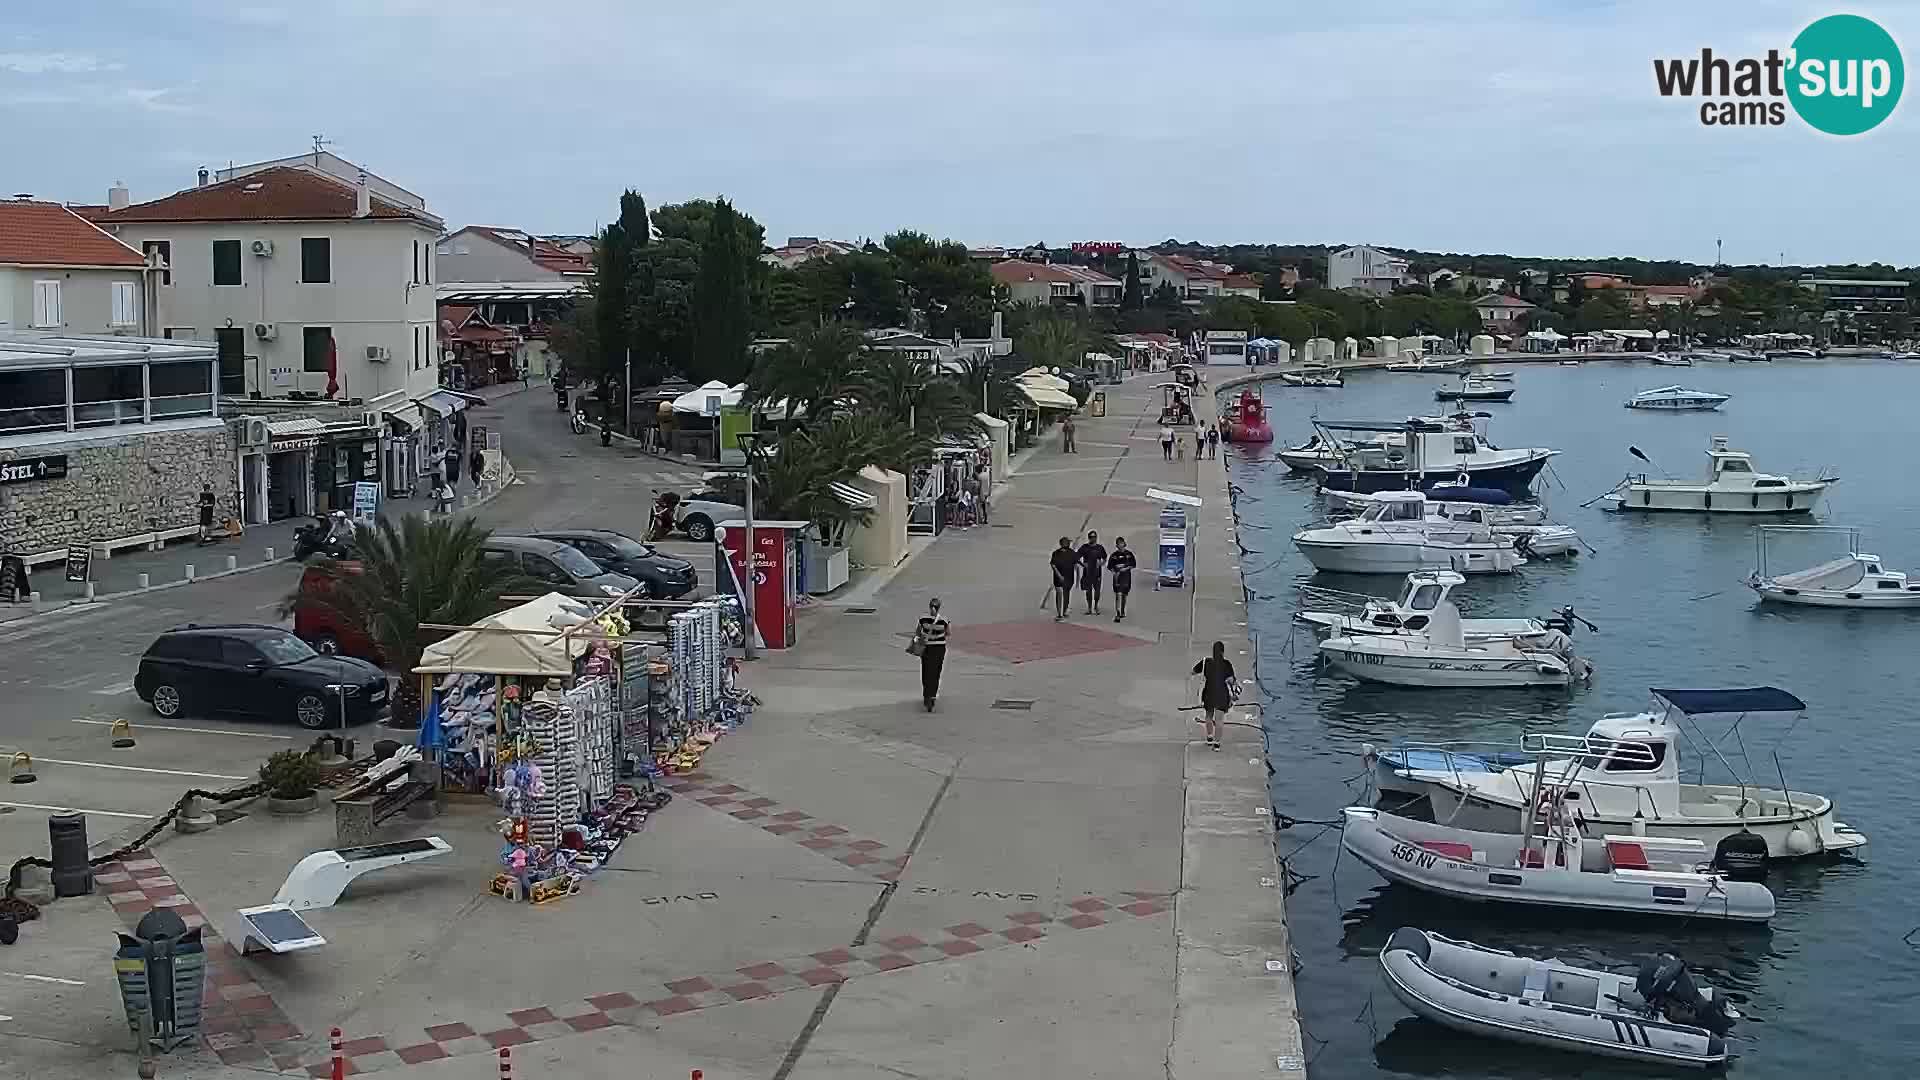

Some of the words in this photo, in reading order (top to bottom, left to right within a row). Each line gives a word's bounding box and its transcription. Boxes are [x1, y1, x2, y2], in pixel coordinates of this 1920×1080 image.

[272, 440, 314, 451] MARKET
[1391, 843, 1415, 863] 456
[1415, 852, 1437, 869] NV
